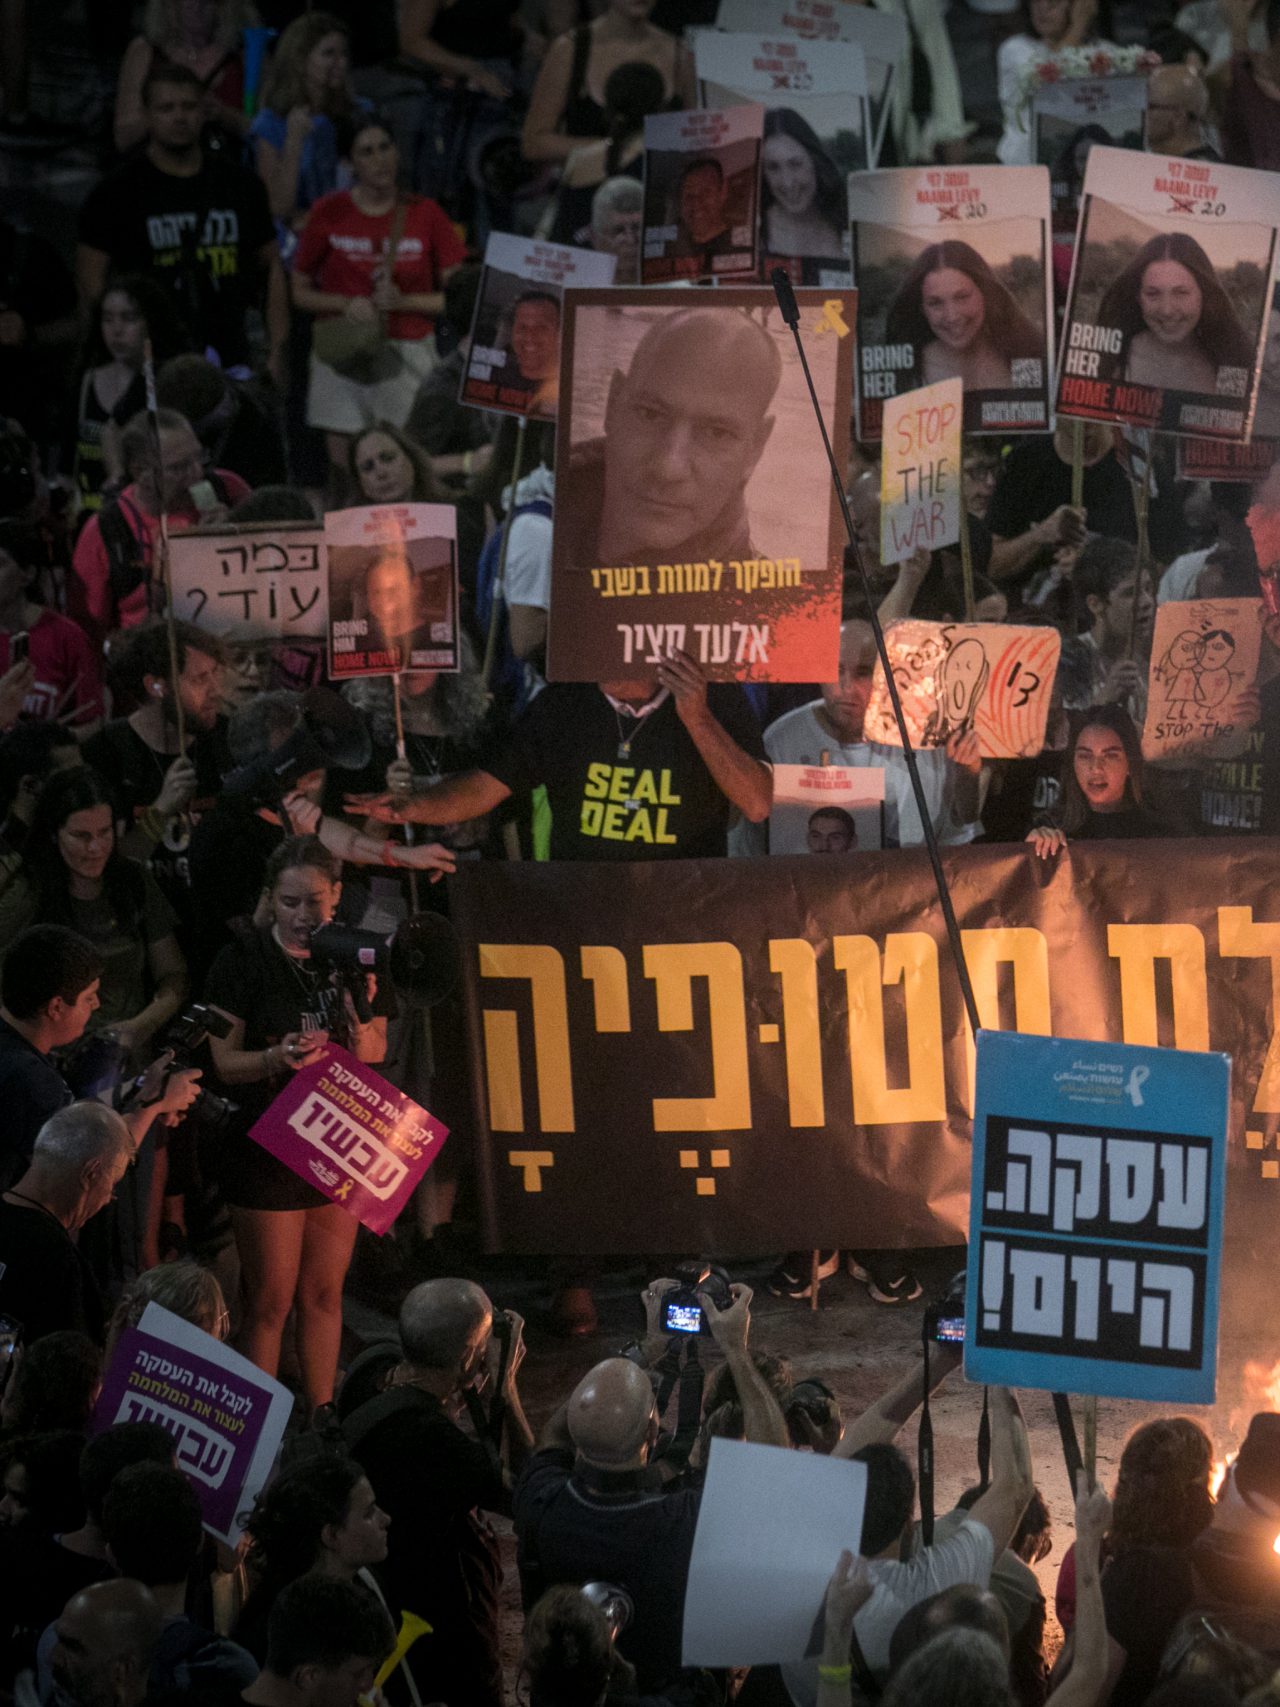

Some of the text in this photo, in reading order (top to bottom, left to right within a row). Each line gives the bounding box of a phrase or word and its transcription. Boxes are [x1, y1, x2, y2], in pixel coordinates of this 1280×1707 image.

[1200, 201, 1226, 217] 20
[861, 343, 915, 371] BRING
[1070, 322, 1123, 354] BRING
[1065, 349, 1101, 378] HER
[863, 371, 897, 399] HER
[1061, 377, 1112, 405] HOME
[897, 402, 958, 456] STOP
[898, 458, 948, 506] THE
[892, 501, 946, 553] WAR
[591, 558, 801, 598] הופקר למוות בשבי
[333, 619, 368, 636] BRING
[693, 623, 770, 664] אלעד
[333, 652, 366, 669] HOME
[1155, 722, 1193, 739] STOP
[583, 762, 682, 806] SEAL
[579, 799, 678, 845] DEAL
[317, 1077, 371, 1123] המלחמה
[328, 1061, 381, 1105] העסקה
[370, 1120, 391, 1139] את
[379, 1103, 404, 1124] את
[302, 1100, 400, 1189] עכשיו
[986, 1128, 1208, 1232] עסקה.
[982, 1240, 1194, 1351] היום!
[134, 1349, 253, 1416] לקבל את העסקה
[128, 1370, 246, 1437] לעצור את המלחמה
